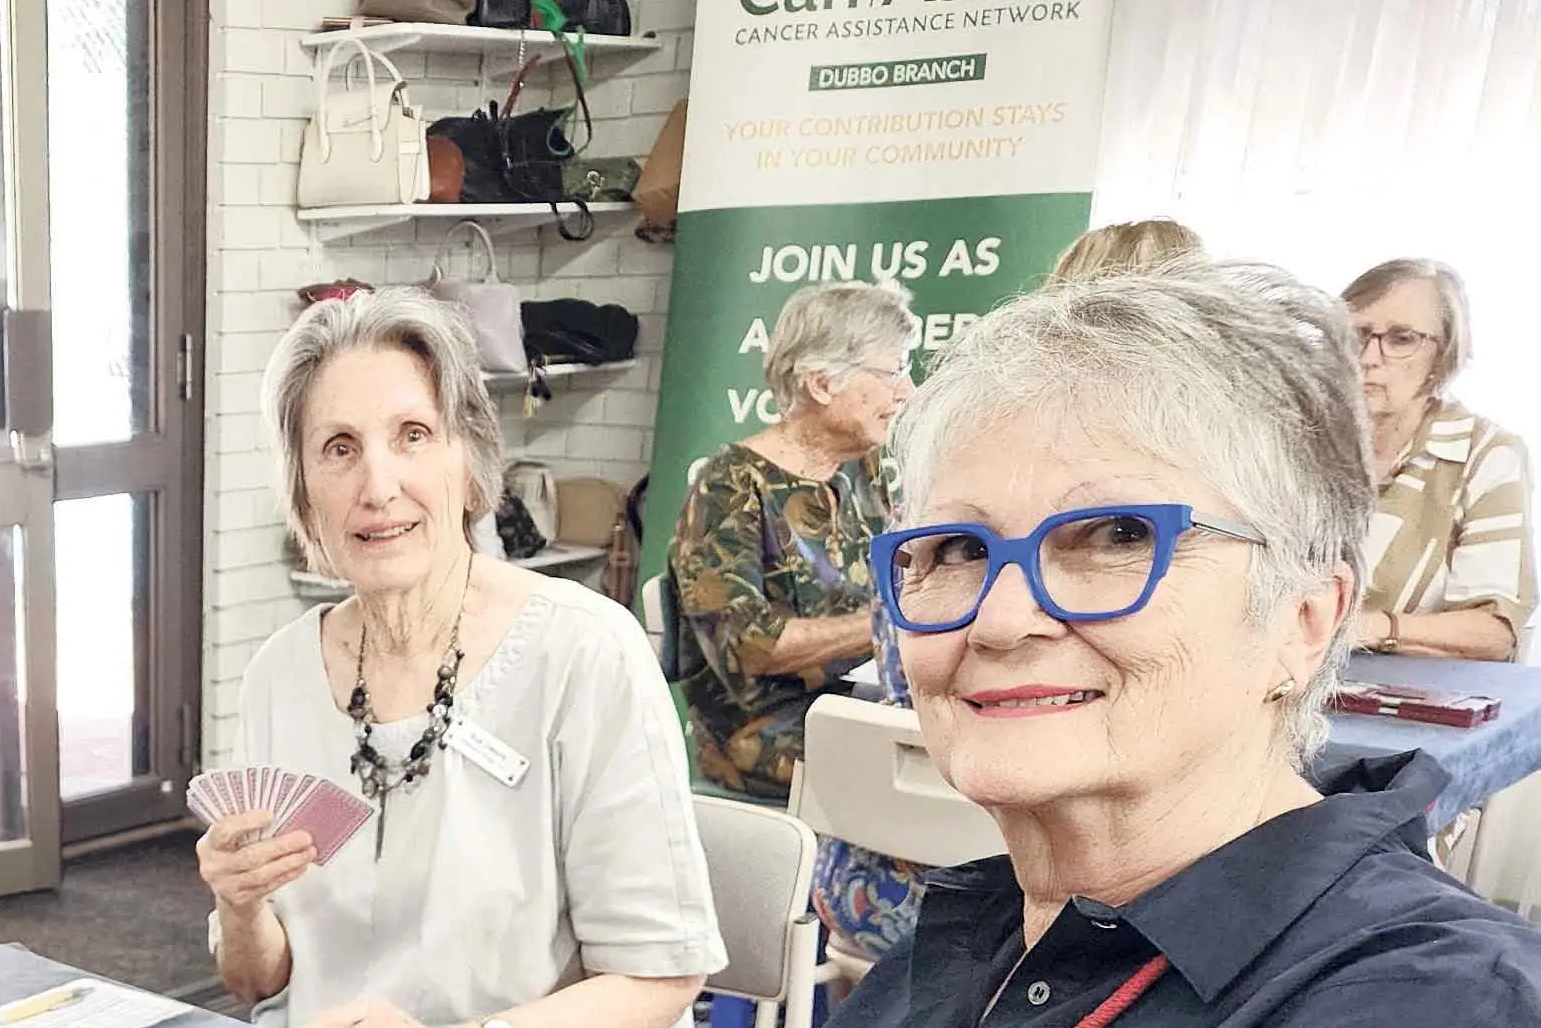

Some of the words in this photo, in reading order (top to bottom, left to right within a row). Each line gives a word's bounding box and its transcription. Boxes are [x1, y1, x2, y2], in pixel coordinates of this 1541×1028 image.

[734, 23, 819, 46] CANCER
[825, 12, 955, 39] ASSISTANCE
[962, 0, 1082, 28] NETWORK
[818, 65, 889, 89] DUBBO
[892, 58, 976, 84] BRANCH
[723, 120, 790, 142] YOUR
[798, 106, 985, 137] CONTRIBUTION
[992, 102, 1068, 127] STAYS
[755, 151, 781, 170] IN
[790, 146, 857, 168] YOUR
[865, 136, 1024, 165] COMMUNITY
[749, 242, 858, 283] JOIN
[871, 240, 929, 280] US
[938, 237, 1002, 278] AS
